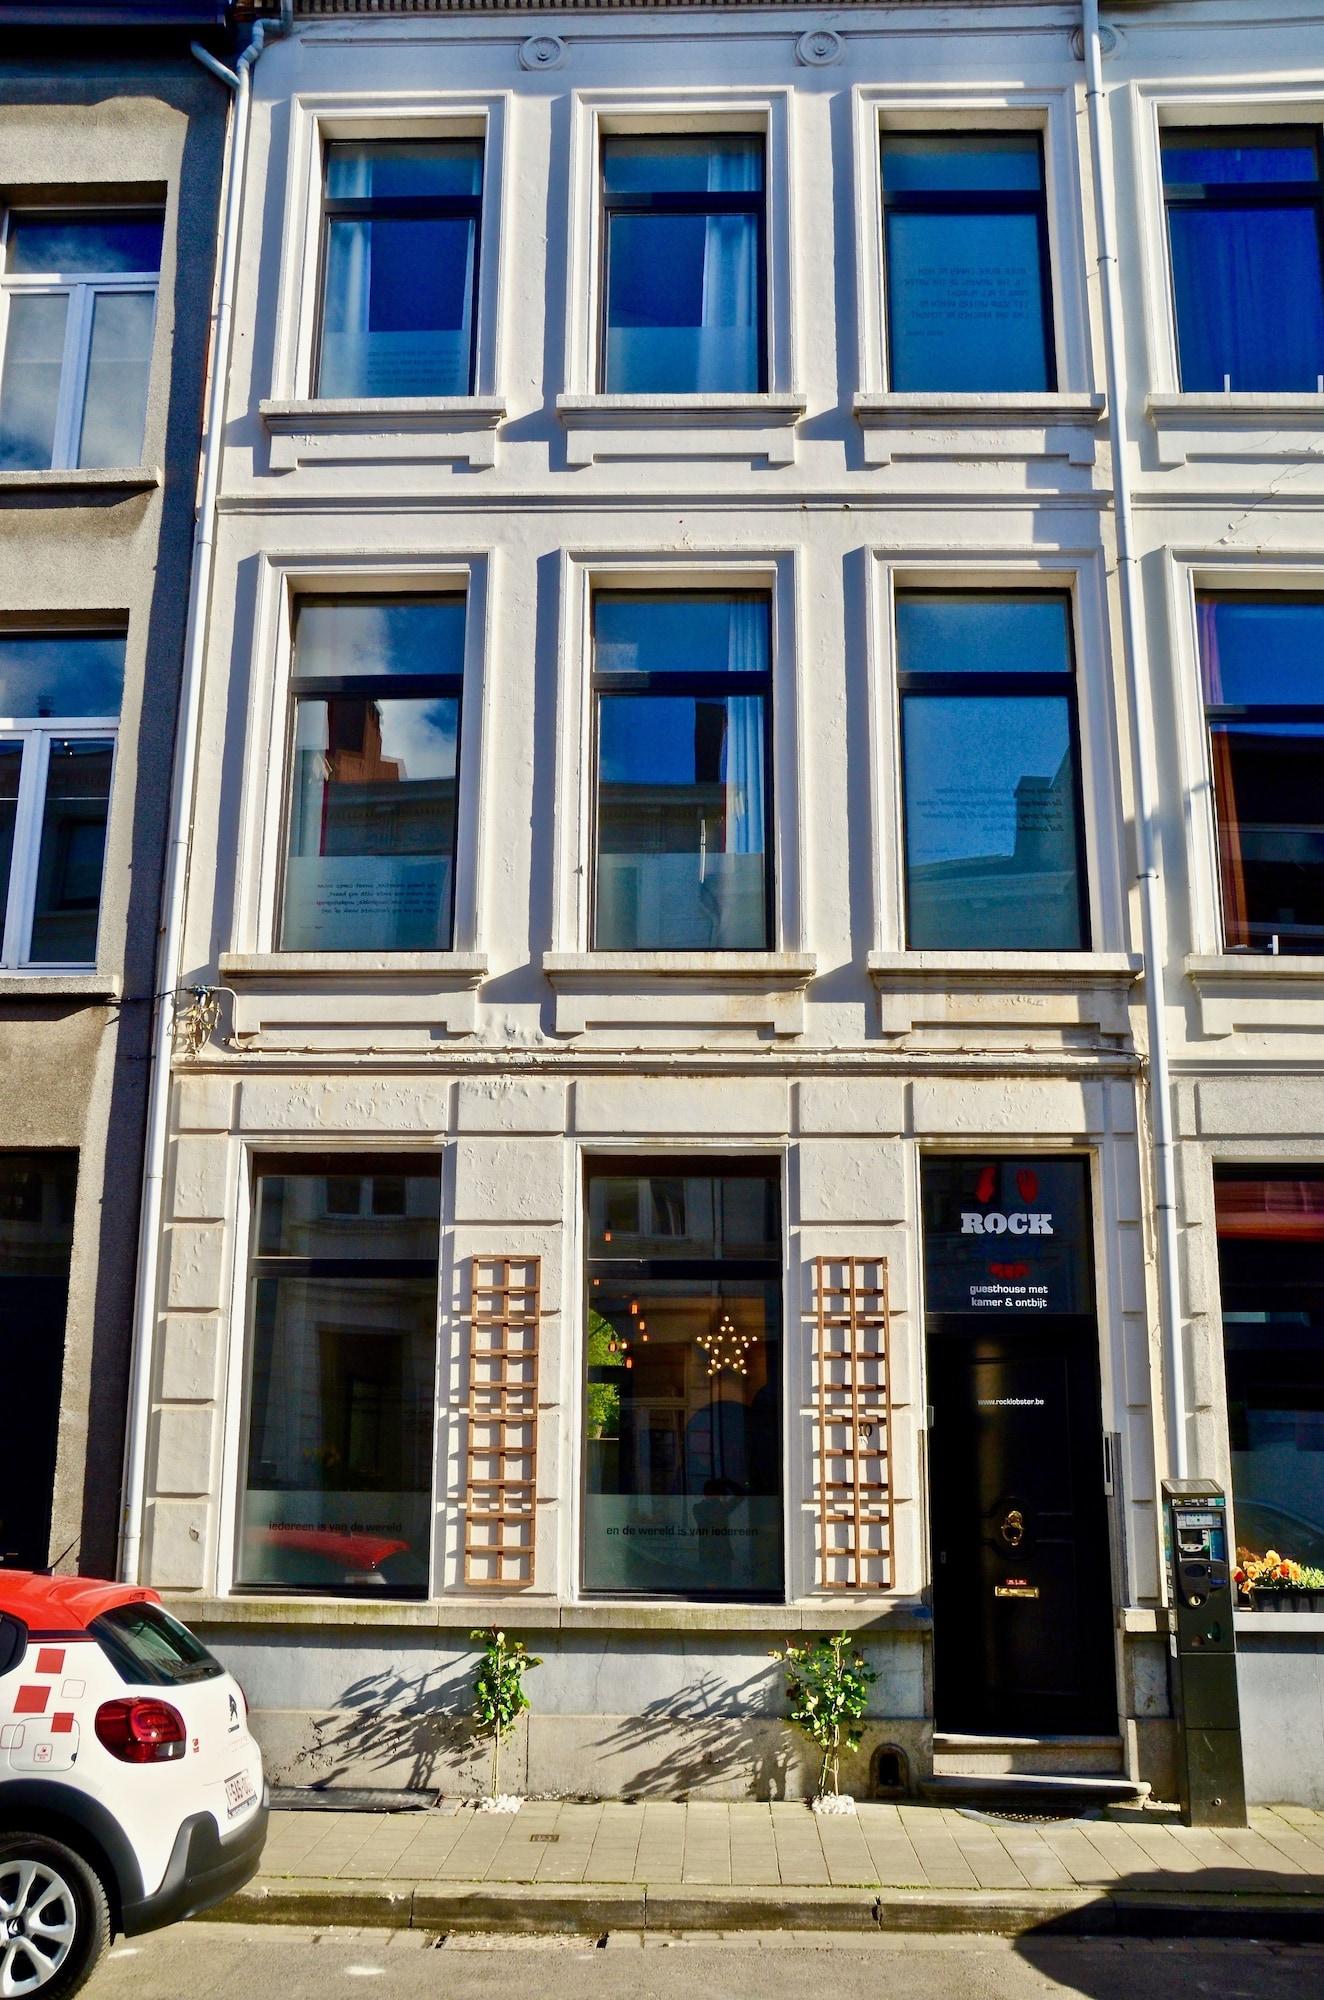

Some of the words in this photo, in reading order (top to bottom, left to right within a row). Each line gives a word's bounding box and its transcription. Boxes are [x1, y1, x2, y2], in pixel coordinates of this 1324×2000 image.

[960, 1212, 1054, 1235] ROCK
[969, 1284, 1027, 1296] guesthouse
[1028, 1284, 1049, 1294] met
[971, 1297, 1003, 1307] kamer
[1004, 1298, 1013, 1307] &
[1014, 1297, 1048, 1309] ontbijt
[269, 1520, 315, 1531] iedereen
[318, 1520, 327, 1531] is
[329, 1522, 348, 1532] van
[350, 1521, 364, 1532] de
[366, 1521, 402, 1532] wereld
[606, 1527, 619, 1535] en
[622, 1525, 636, 1536] de
[638, 1525, 675, 1536] wereld
[688, 1527, 708, 1536] van
[711, 1525, 759, 1536] iedereen
